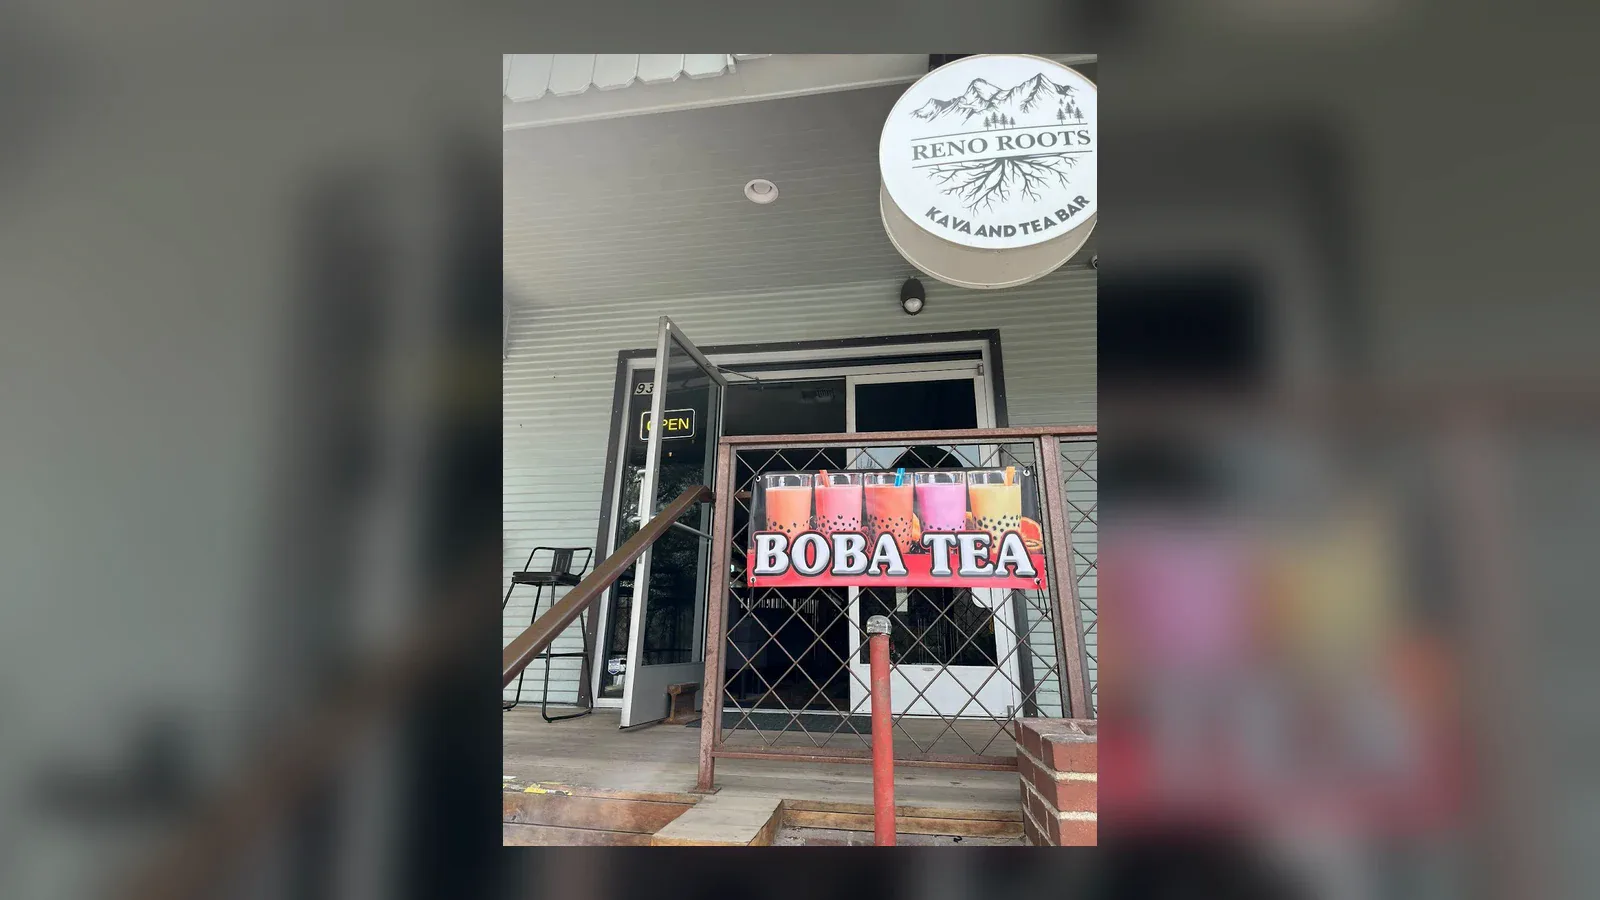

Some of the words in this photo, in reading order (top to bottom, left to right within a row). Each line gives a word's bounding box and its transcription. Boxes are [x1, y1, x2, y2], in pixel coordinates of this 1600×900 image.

[912, 137, 988, 162] RENO
[996, 129, 1092, 151] ROOTS
[925, 206, 972, 235] KAVA
[973, 224, 1017, 238] AND
[1019, 216, 1056, 235] TEA
[1054, 194, 1091, 222] BAR
[753, 532, 908, 576] BOBA
[922, 531, 1038, 577] TEA
